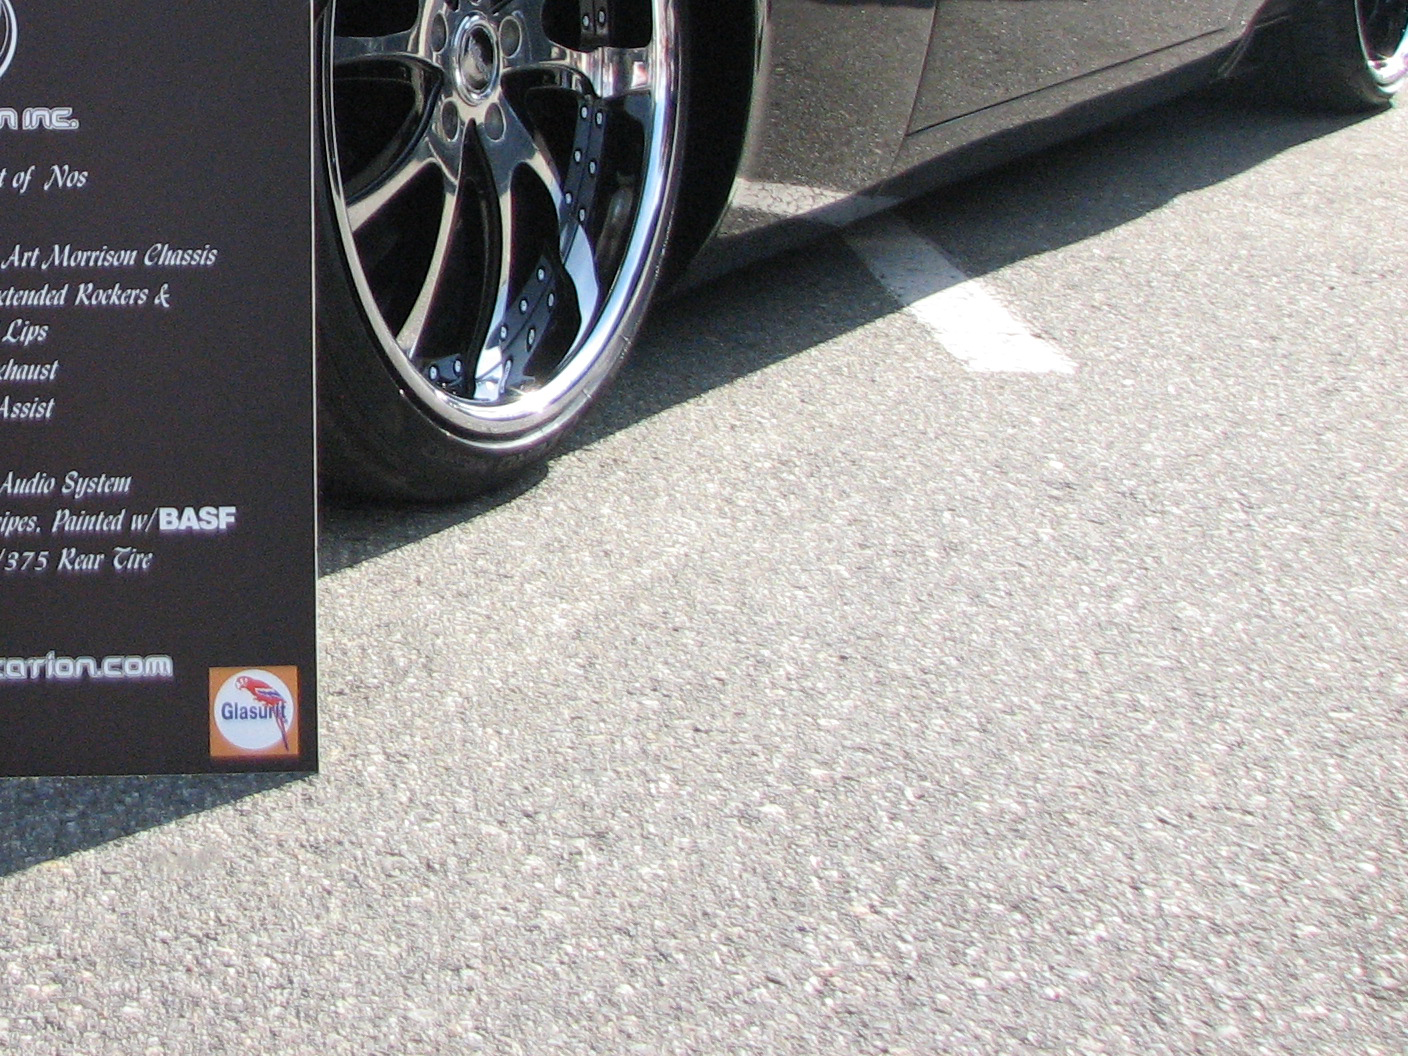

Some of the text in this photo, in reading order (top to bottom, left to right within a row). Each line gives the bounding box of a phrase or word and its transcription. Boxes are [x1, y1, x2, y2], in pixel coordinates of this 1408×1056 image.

[12, 165, 35, 194] of
[44, 164, 88, 190] Nos
[0, 244, 40, 269] Art
[41, 244, 138, 269] Morrison
[144, 243, 218, 266] Chassis
[74, 282, 149, 307] Rockers
[153, 283, 171, 308] &
[2, 319, 49, 347] Lips
[61, 470, 131, 499] System
[52, 509, 126, 533] Painted
[57, 547, 105, 570] Rear
[112, 546, 154, 570] Tire
